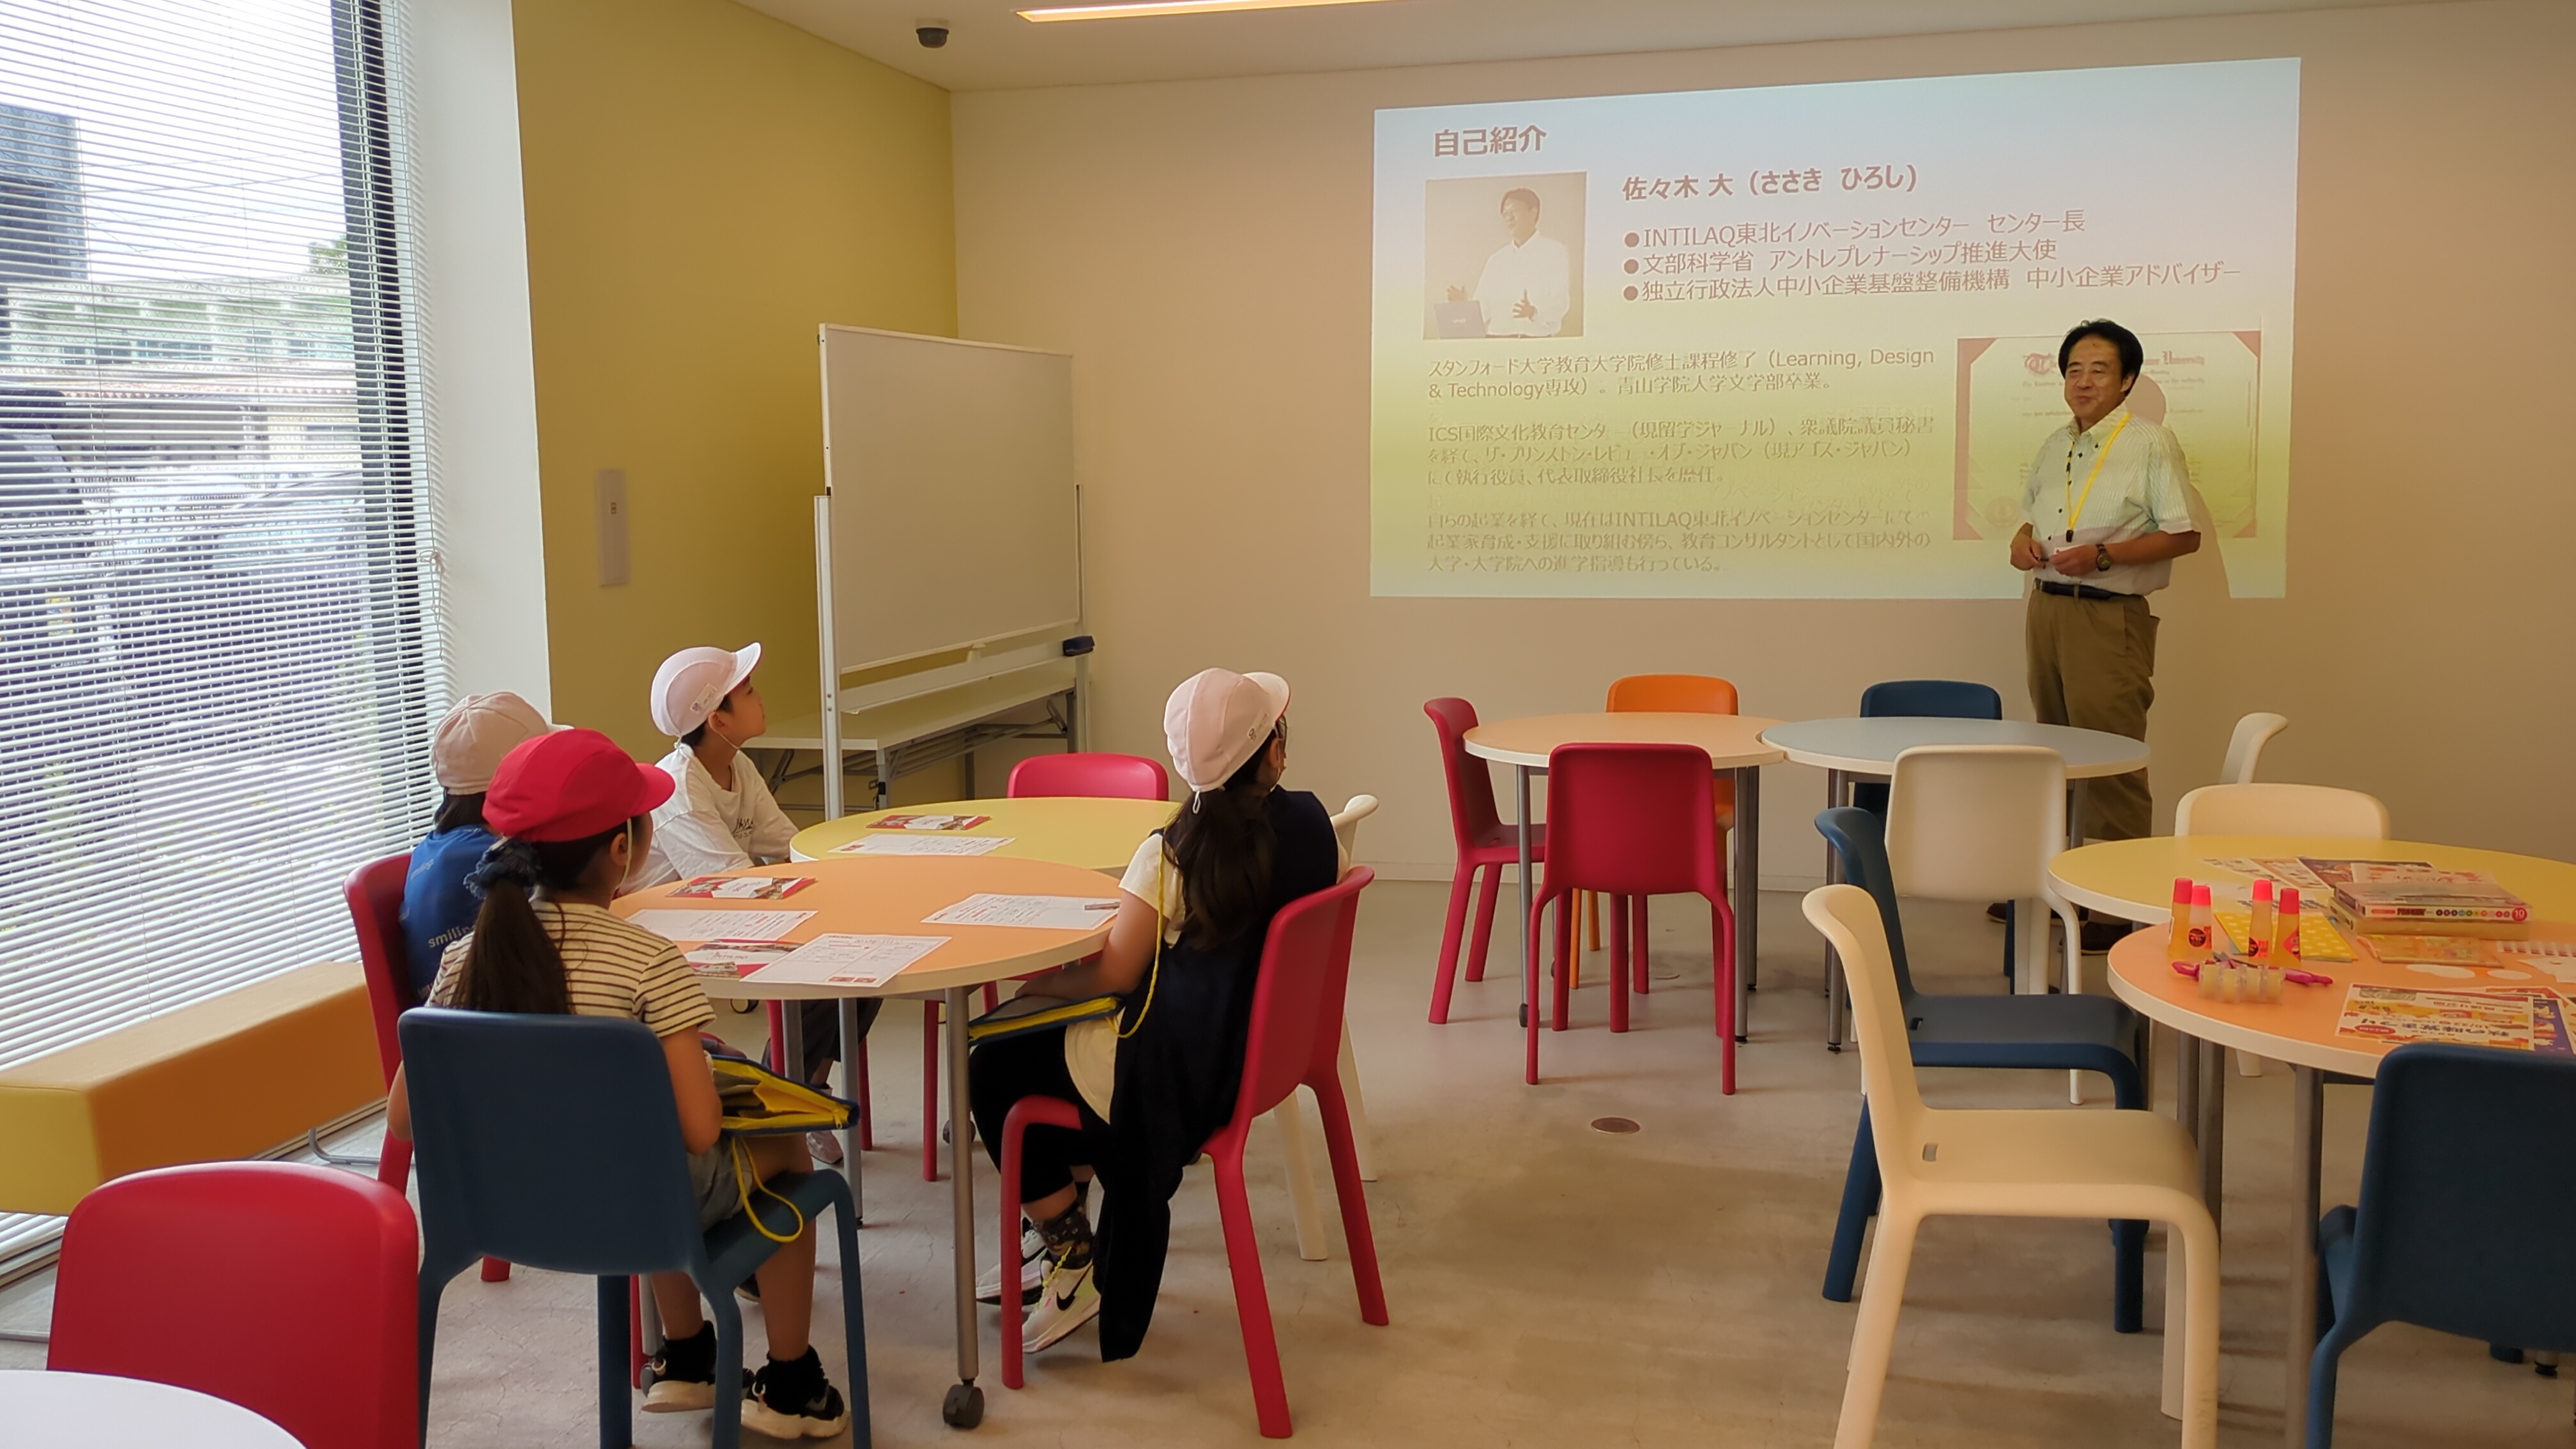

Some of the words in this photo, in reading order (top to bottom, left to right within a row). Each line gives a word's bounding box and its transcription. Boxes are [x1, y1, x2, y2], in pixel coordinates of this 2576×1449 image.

[1434, 125, 1547, 157] 自己紹介
[1622, 175, 1698, 201] 佐々木
[1643, 216, 1969, 247] INTILAQ東北イノベーションセンター
[1988, 209, 2085, 234] センター長
[1643, 250, 1753, 275] 文部科学省
[1768, 239, 2057, 271] アントレプレナーシップ推進大使
[1642, 268, 2010, 302] 独立行政法人中小企業基盤整備機構
[2027, 261, 2240, 289] 中小企業アドバイザー
[1870, 349, 1934, 368] Design
[1429, 385, 1441, 399] &
[428, 925, 476, 948] smilin
